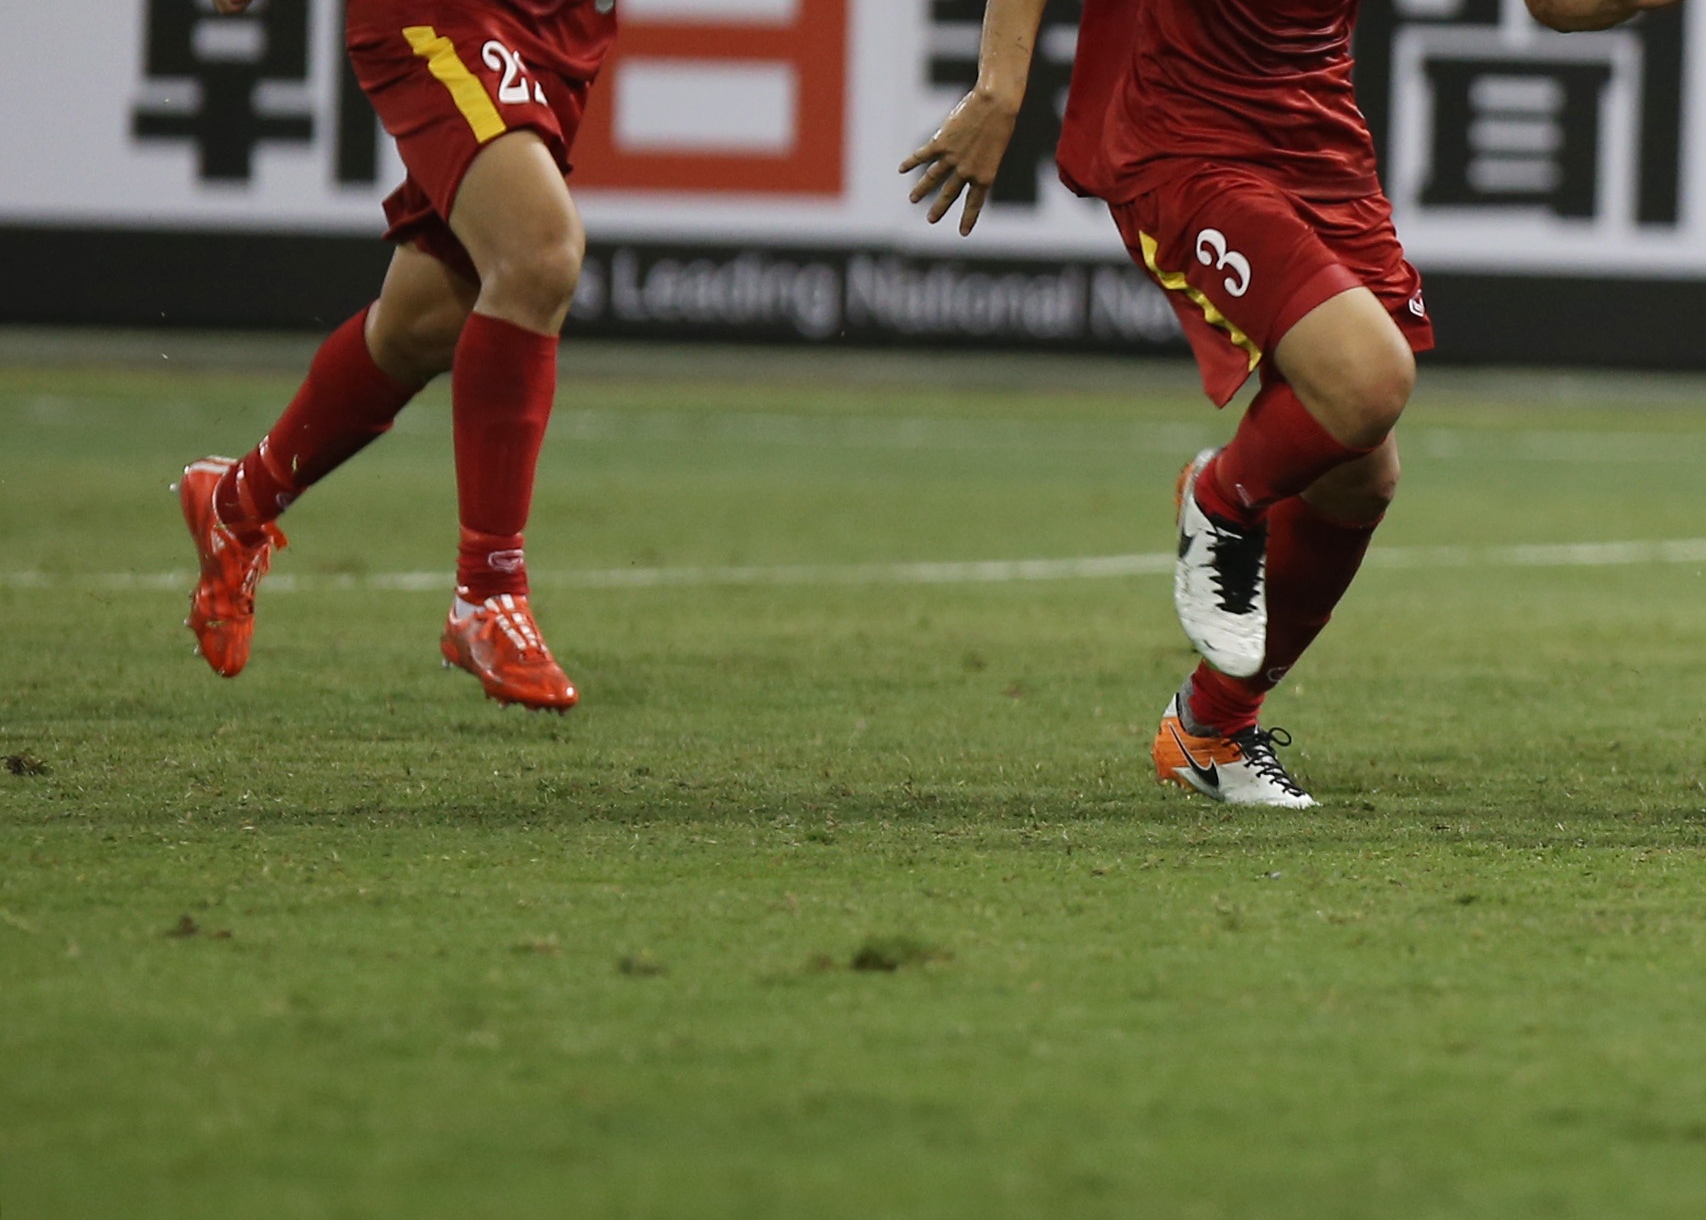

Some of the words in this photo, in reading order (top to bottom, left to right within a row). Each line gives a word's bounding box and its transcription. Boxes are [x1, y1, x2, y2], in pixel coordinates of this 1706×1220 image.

[611, 247, 840, 338] Leading
[846, 253, 1086, 338] National
[1195, 227, 1252, 298] 3
